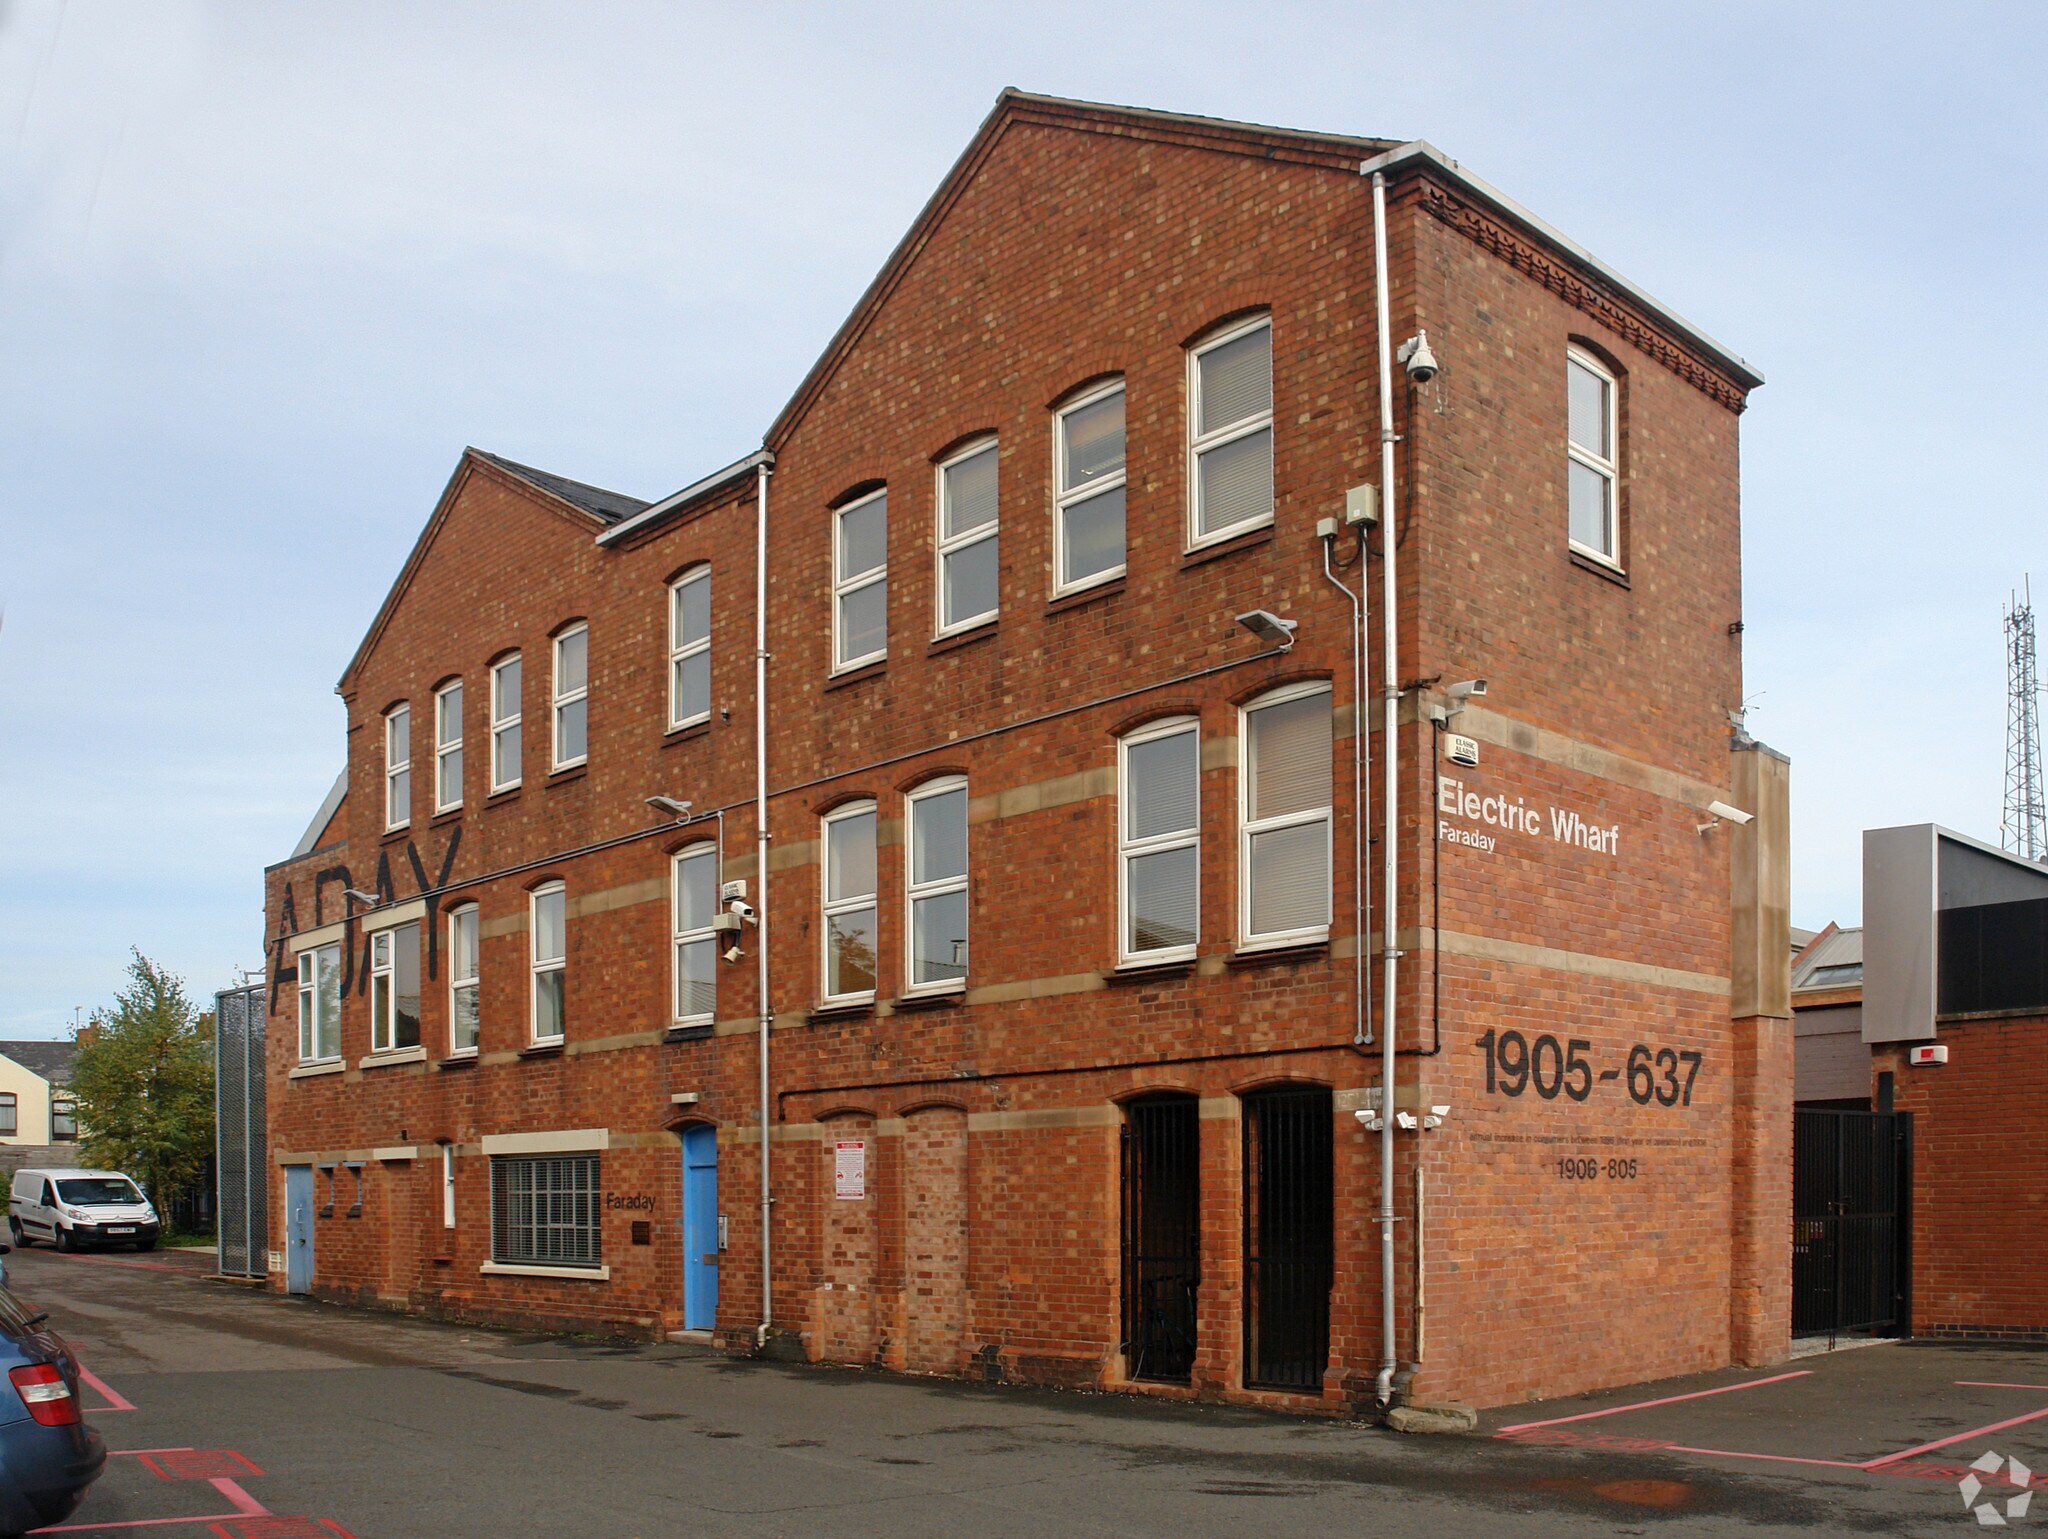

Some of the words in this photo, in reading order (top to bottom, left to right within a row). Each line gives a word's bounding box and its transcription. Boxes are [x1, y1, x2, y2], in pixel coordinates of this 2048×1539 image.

[1455, 738, 1476, 750] CLASSIC
[1439, 820, 1496, 855] Faraday
[1550, 806, 1619, 856] Wharf
[606, 1191, 656, 1213] Faraday
